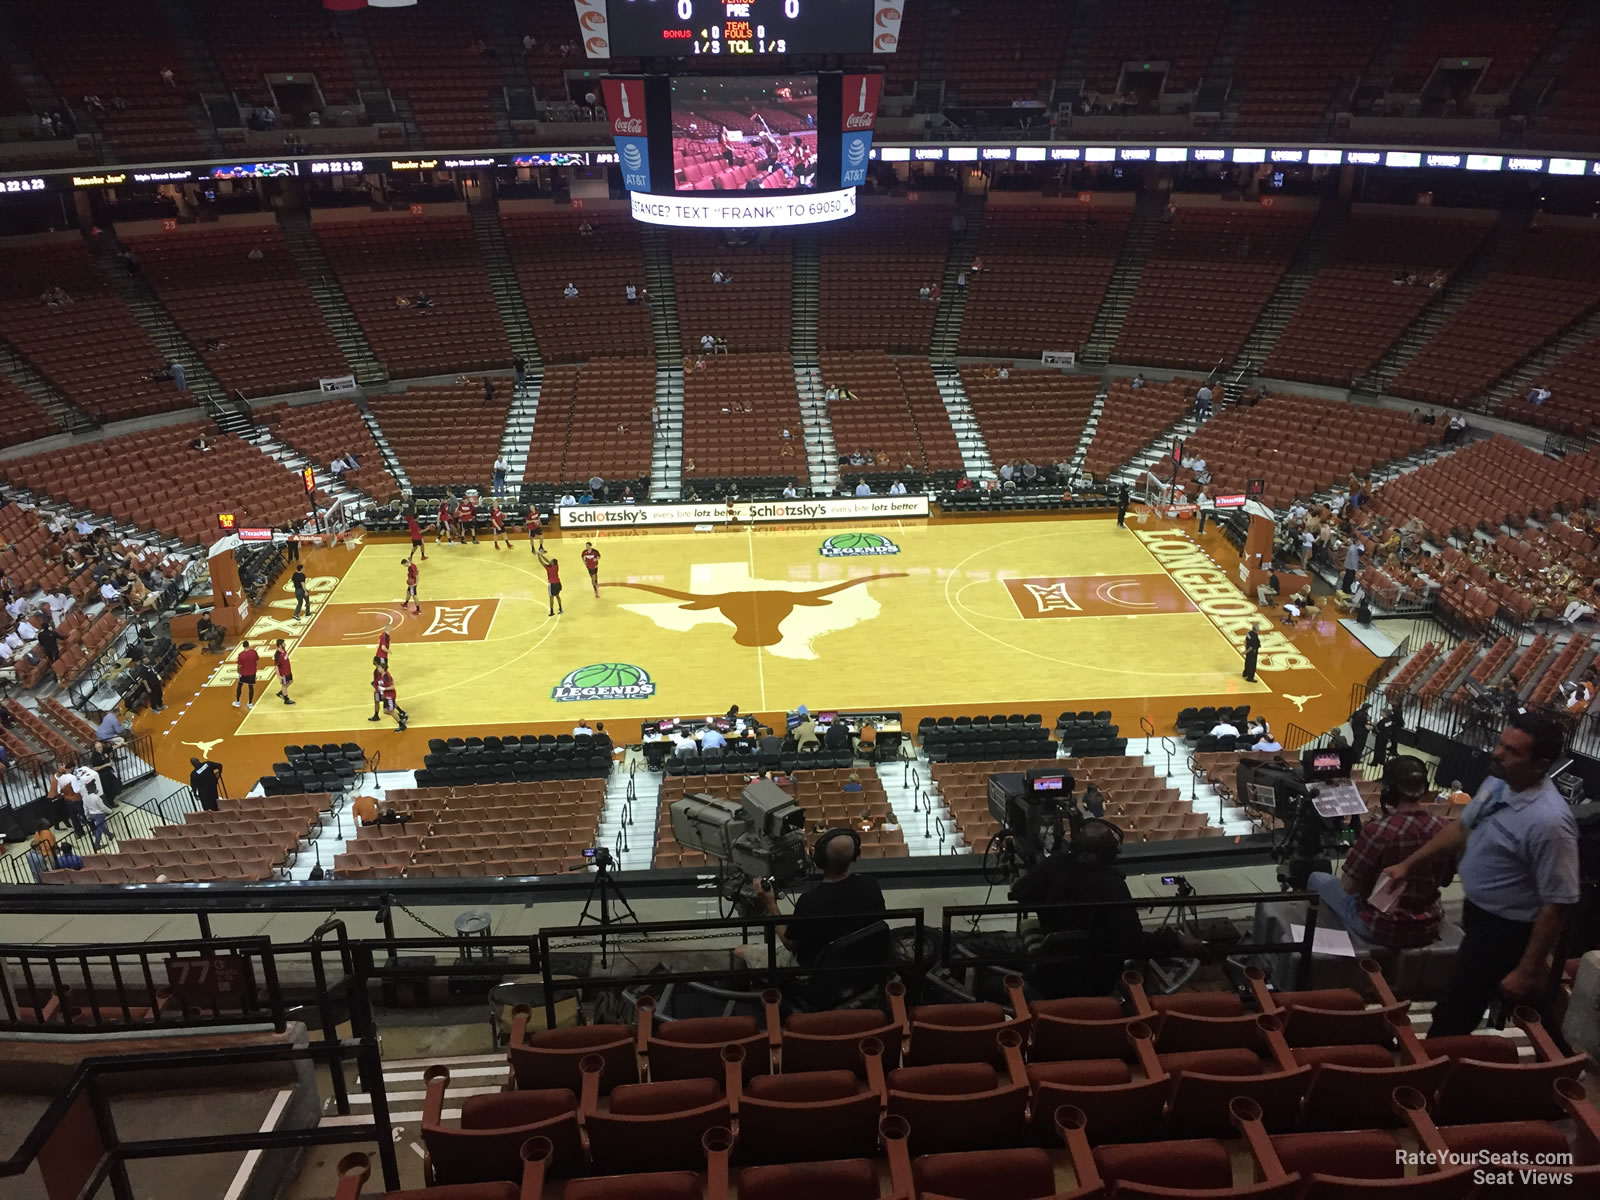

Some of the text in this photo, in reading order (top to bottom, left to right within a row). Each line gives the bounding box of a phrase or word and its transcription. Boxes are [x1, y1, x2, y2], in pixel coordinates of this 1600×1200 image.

[726, 3, 750, 17] PRE
[711, 25, 720, 39] 0
[726, 21, 749, 30] TEAM
[757, 25, 765, 38] 0
[663, 30, 692, 39] BONUS
[724, 30, 753, 39] FOULS
[727, 40, 753, 53] TOL
[626, 174, 647, 187] AT&T
[843, 169, 865, 182] AT&T
[412, 206, 423, 214] 22
[573, 199, 583, 208] 21
[674, 205, 710, 219] TEXT
[786, 204, 805, 217] TO
[808, 199, 842, 215] 69050
[163, 221, 176, 229] 23
[568, 509, 648, 523] Schlotzsky's
[694, 509, 711, 517] lotz
[749, 503, 827, 518] Schlotzsky's
[871, 503, 888, 511] lotz
[890, 502, 919, 511] better
[821, 545, 899, 555] LEGENDS
[1133, 528, 1316, 672] LONGHORNS
[207, 576, 340, 687] TEXAS
[554, 684, 654, 697] LEGENDS
[561, 693, 645, 701] CLASSIC
[170, 960, 210, 984] 77
